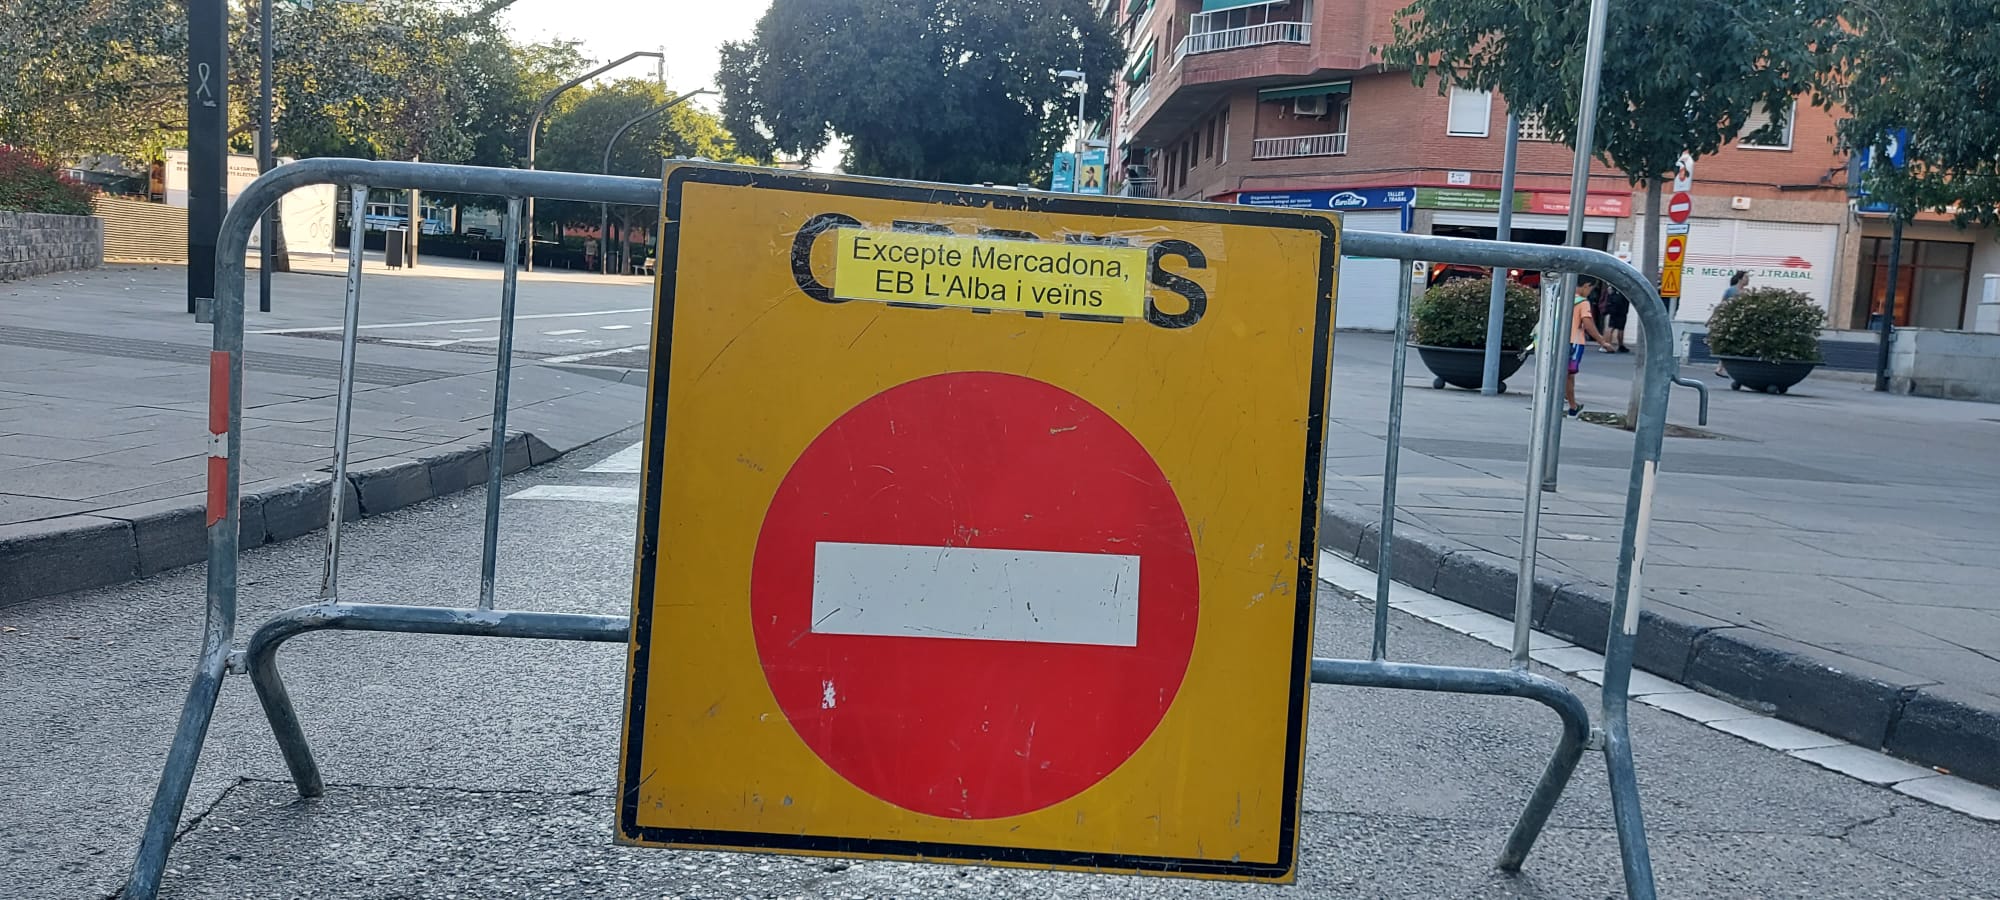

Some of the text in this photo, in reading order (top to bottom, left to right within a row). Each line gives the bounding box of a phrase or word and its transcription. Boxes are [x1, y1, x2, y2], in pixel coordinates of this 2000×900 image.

[853, 236, 1129, 282] Excepte Mercadona,
[1701, 268, 1755, 277] MECAC
[876, 269, 1103, 307] EB L'Alba i veïns
